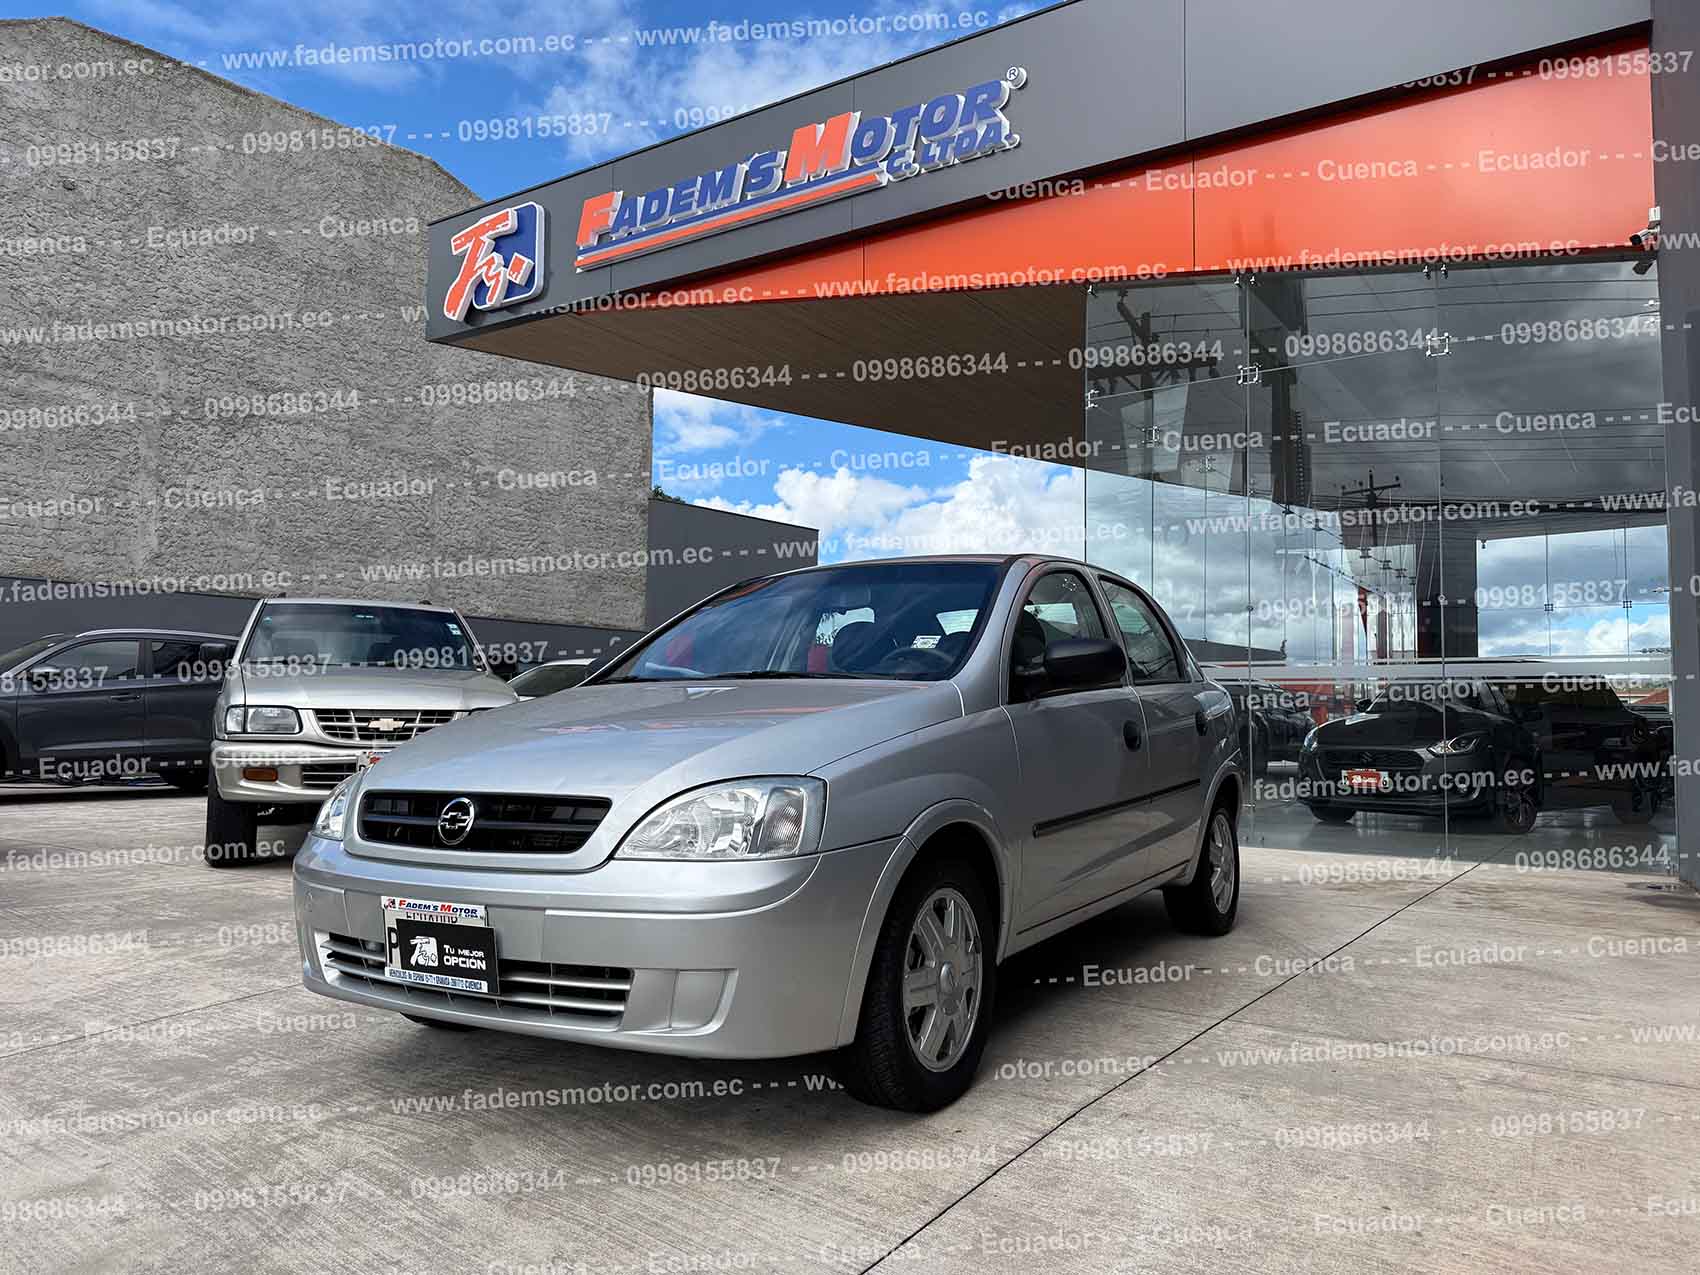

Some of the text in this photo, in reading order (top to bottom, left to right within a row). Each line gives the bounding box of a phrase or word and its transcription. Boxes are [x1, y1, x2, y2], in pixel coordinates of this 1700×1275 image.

[784, 79, 1009, 183] MOTOR
[440, 903, 478, 915] MOTOR
[457, 948, 485, 958] MEJOR
[443, 955, 487, 970] OPCIÓN
